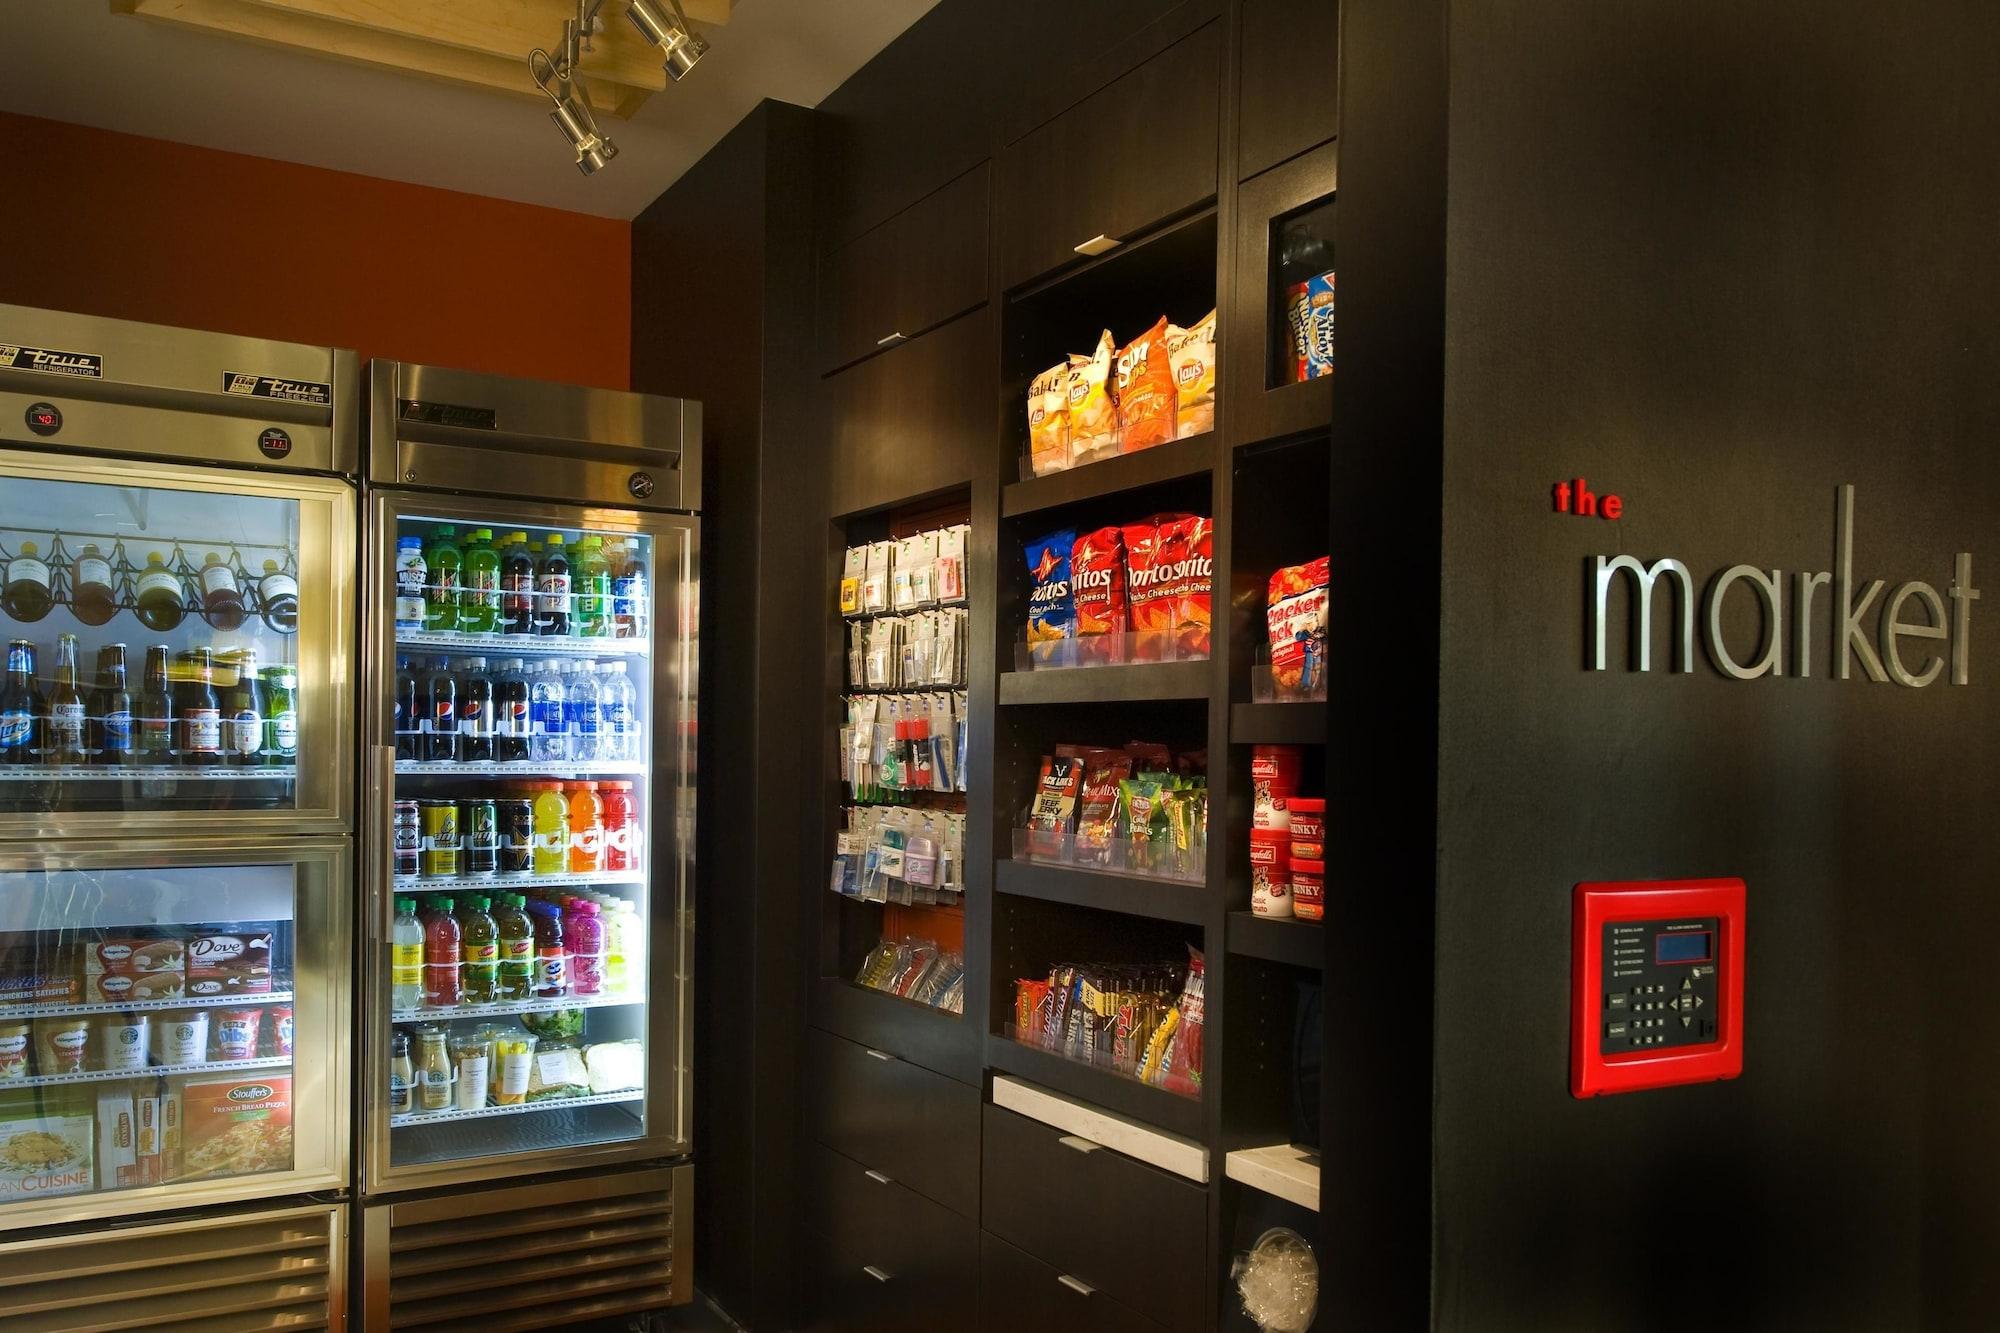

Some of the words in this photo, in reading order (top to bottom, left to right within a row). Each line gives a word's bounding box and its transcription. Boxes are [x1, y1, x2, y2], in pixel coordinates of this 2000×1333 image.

[33, 363, 95, 376] REFRIGERATOR
[1553, 478, 1623, 520] the
[1586, 484, 1981, 688] market
[1080, 593, 1107, 602] Cheese
[192, 939, 240, 955] Dove
[232, 1087, 268, 1099] Stouffer's
[241, 1102, 264, 1111] BREAD
